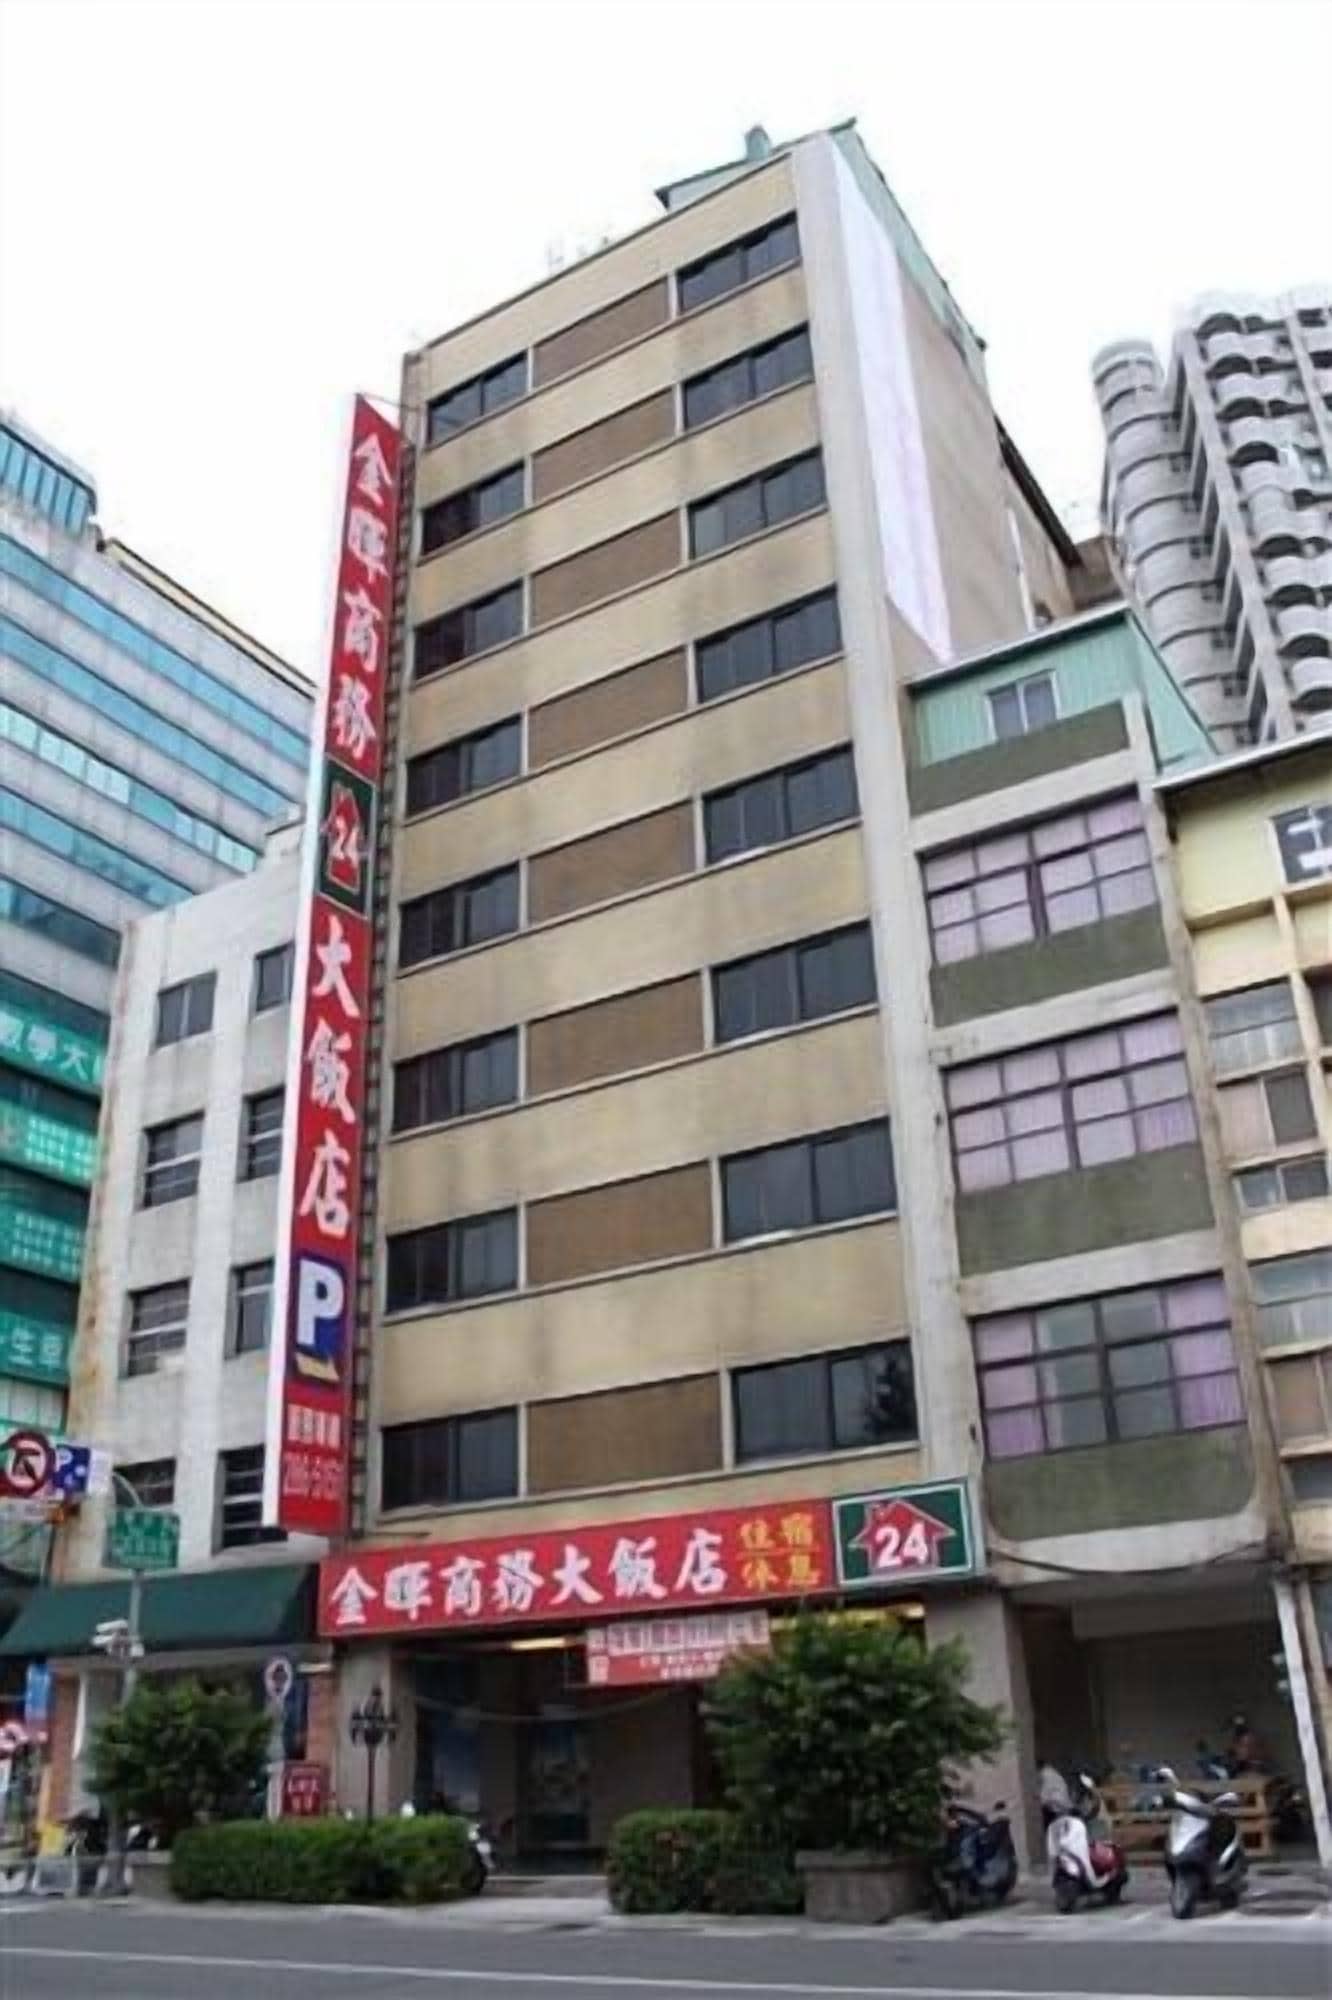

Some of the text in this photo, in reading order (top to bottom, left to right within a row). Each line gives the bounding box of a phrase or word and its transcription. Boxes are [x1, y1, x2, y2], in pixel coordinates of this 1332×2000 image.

[301, 914, 361, 1239] 大飯店
[297, 1258, 344, 1346] P
[875, 1521, 929, 1568] 24
